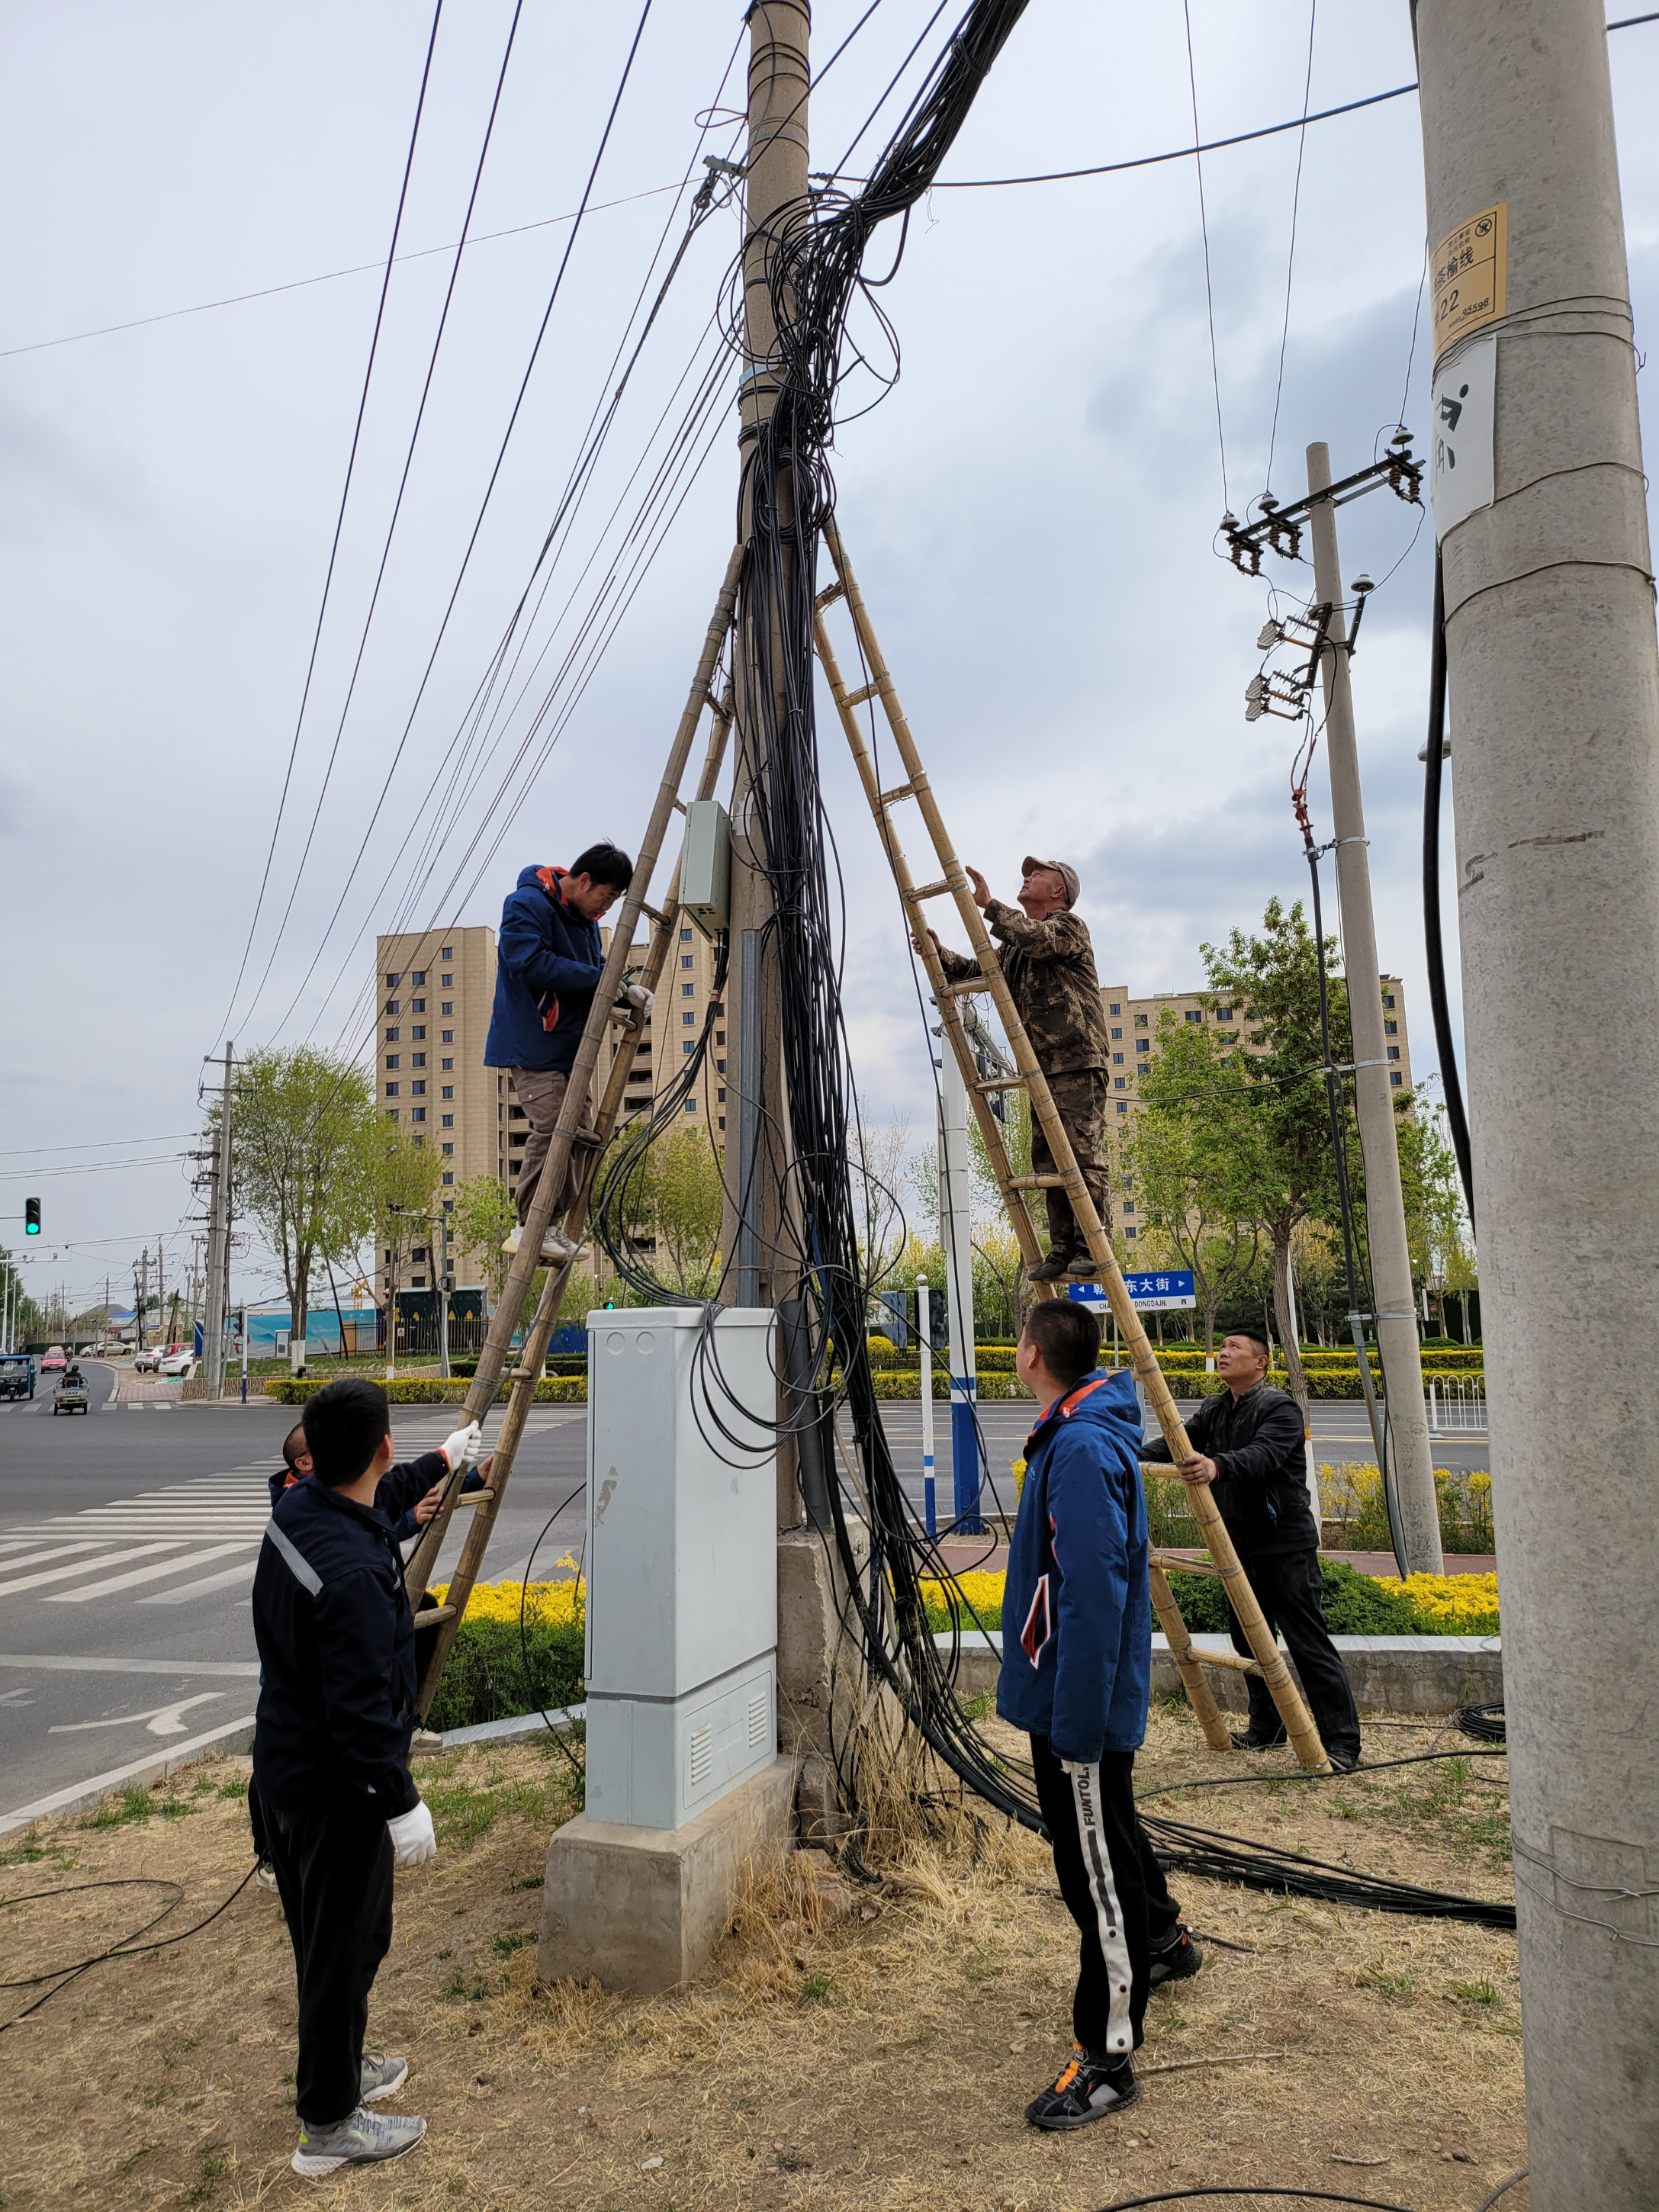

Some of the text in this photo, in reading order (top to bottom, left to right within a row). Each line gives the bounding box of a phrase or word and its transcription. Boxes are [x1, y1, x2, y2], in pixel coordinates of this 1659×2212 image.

[1462, 297, 1490, 316] 95598
[1093, 1278, 1170, 1295] 朝东大街
[1134, 1299, 1167, 1307] DONGDAJIE
[1077, 1766, 1096, 1826] FUNTOL
